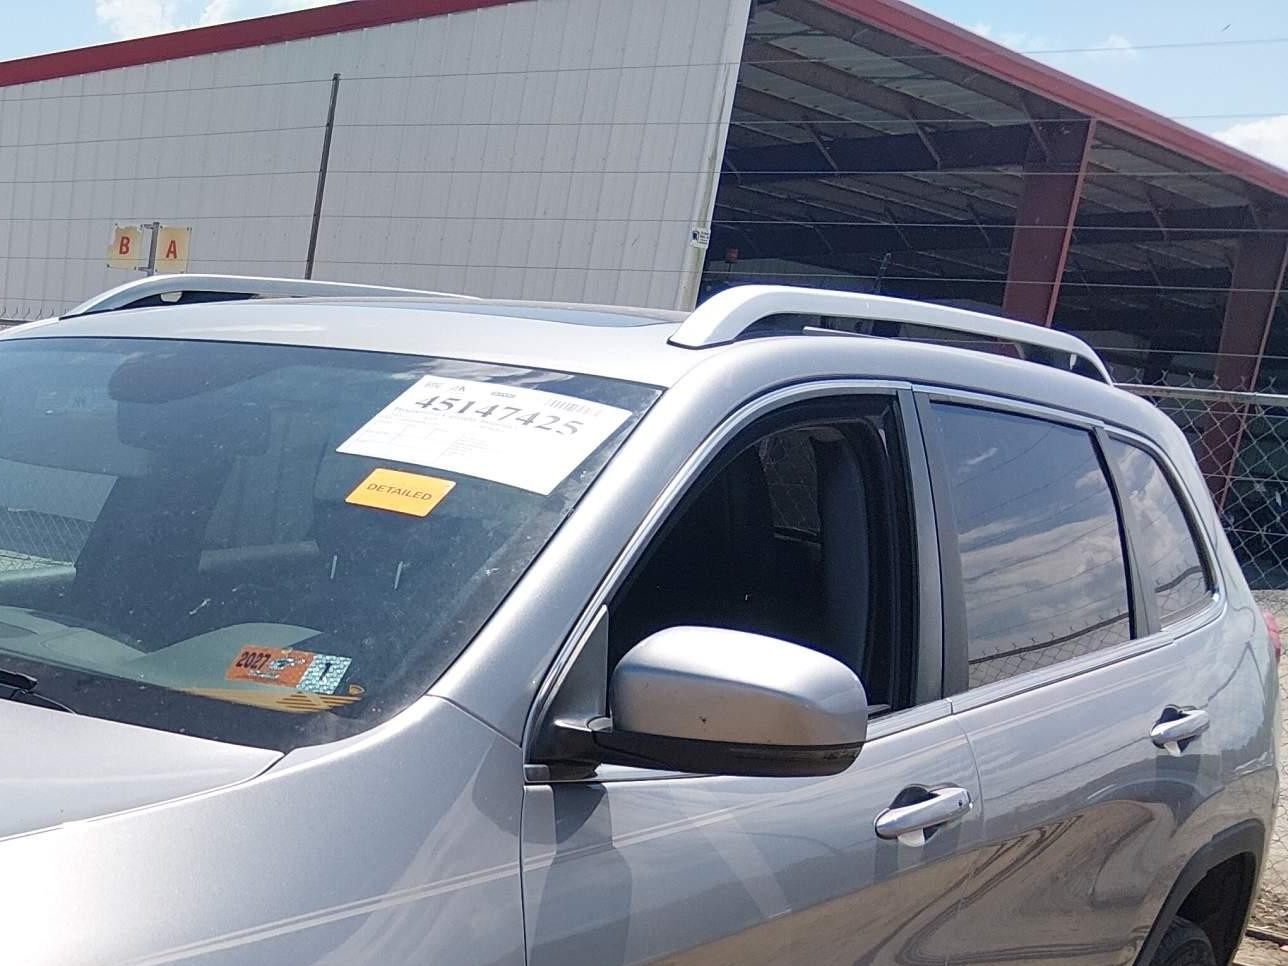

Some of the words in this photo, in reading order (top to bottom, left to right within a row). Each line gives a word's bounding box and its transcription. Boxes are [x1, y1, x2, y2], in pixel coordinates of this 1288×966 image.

[118, 235, 131, 255] B
[165, 239, 178, 259] A
[414, 394, 585, 436] 45147425
[366, 482, 433, 503] DETAILED
[234, 650, 272, 671] 2027
[319, 662, 332, 681] 1
